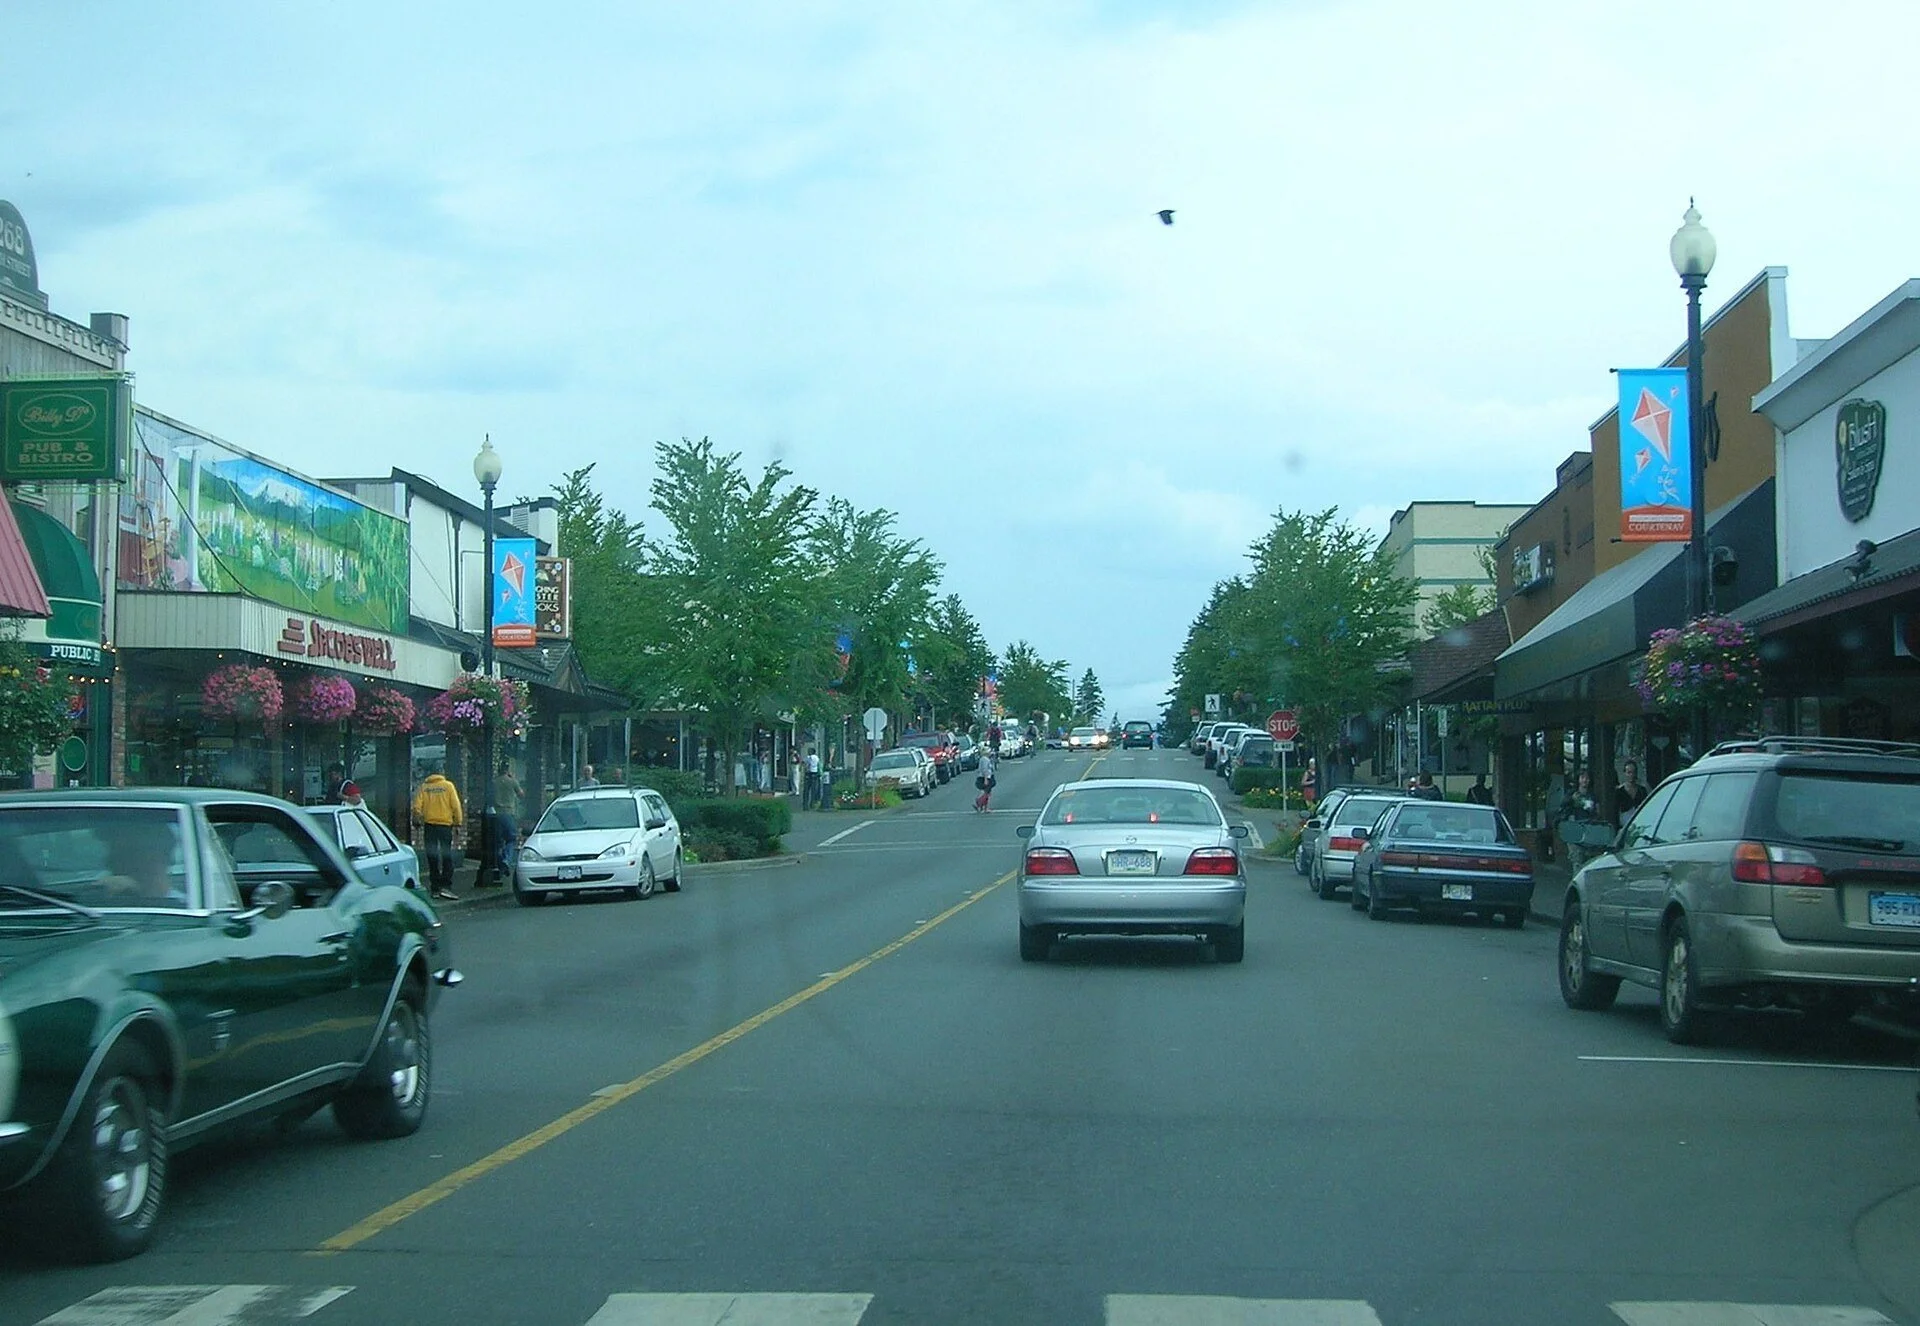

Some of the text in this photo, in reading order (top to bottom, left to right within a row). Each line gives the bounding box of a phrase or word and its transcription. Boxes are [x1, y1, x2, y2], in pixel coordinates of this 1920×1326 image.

[23, 442, 89, 453] PUB &
[19, 453, 93, 464] BISTRO
[50, 645, 92, 660] PUBLIC
[1269, 720, 1297, 731] STOP
